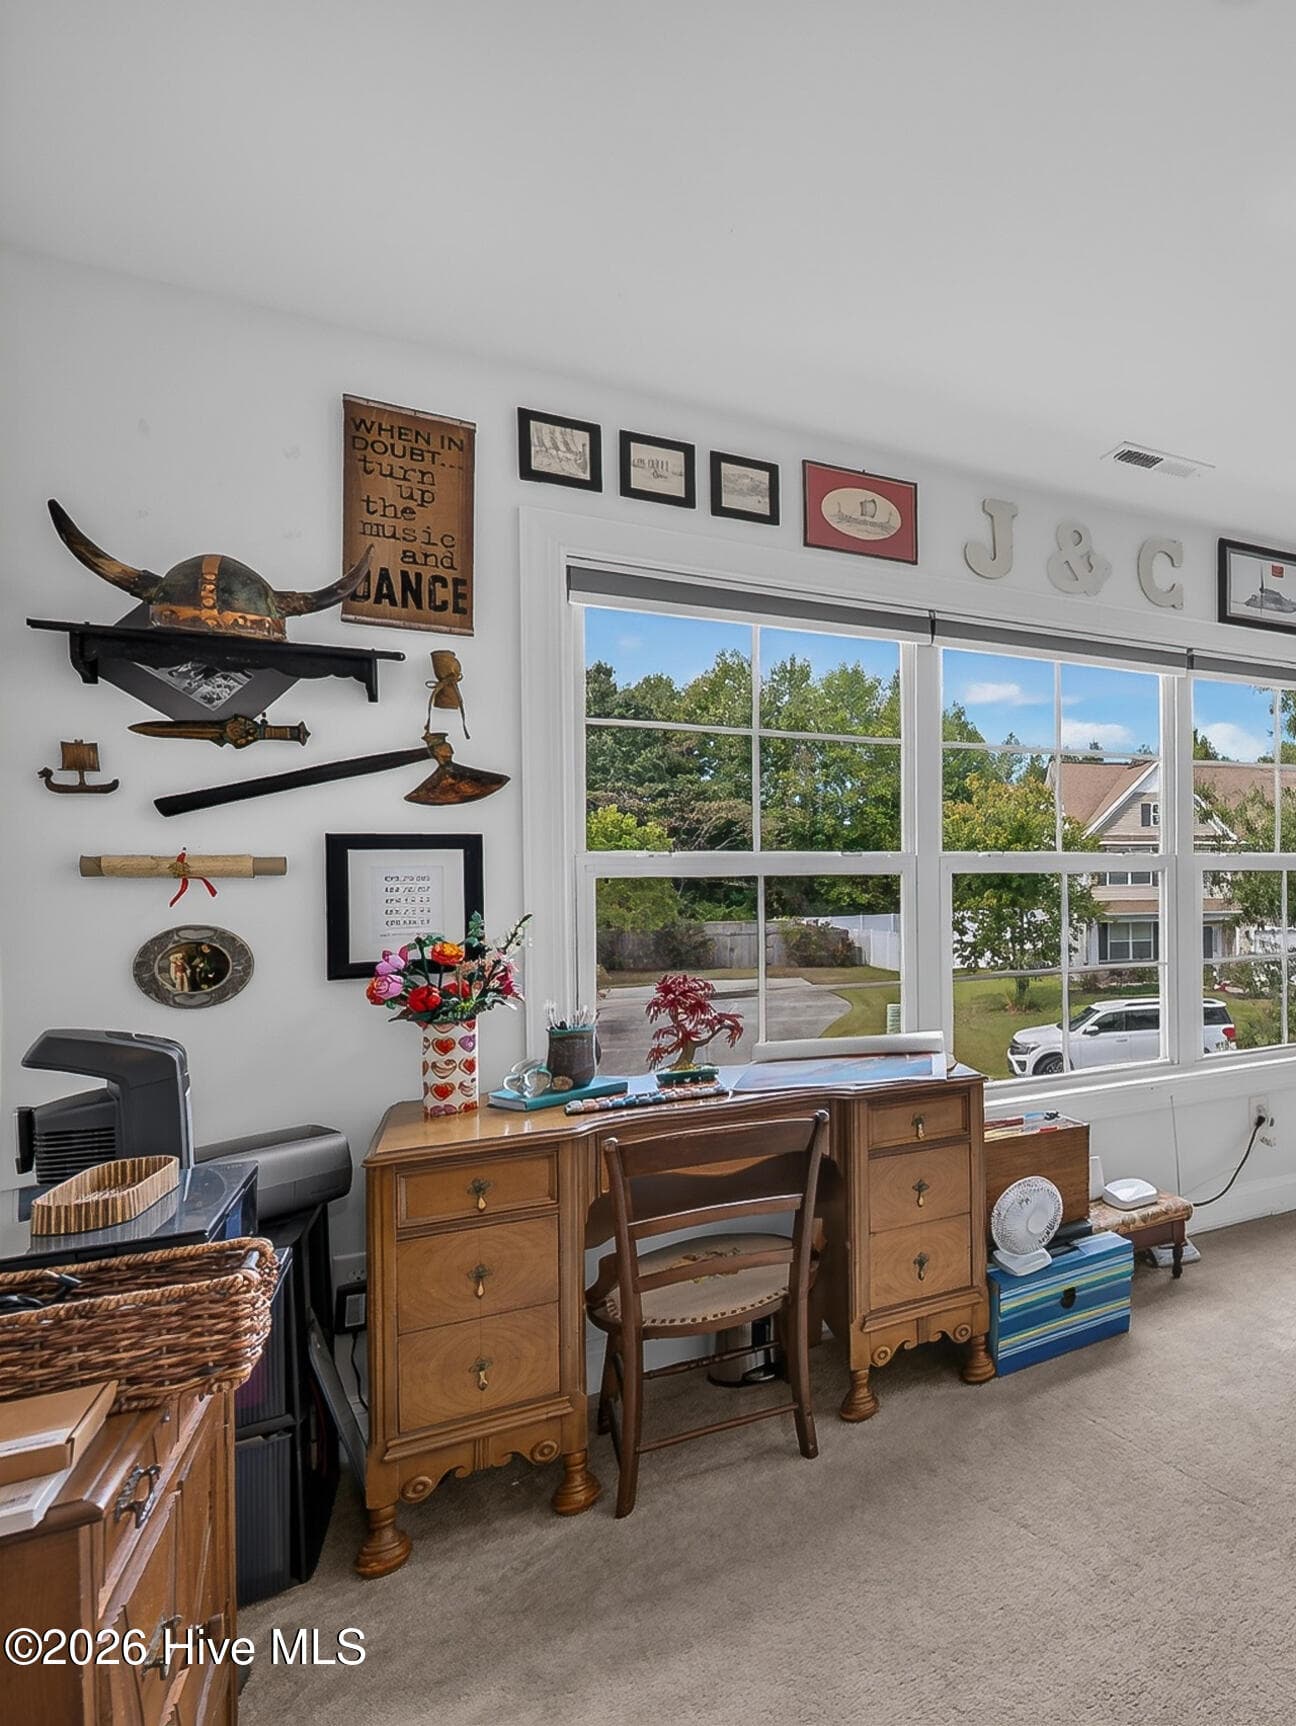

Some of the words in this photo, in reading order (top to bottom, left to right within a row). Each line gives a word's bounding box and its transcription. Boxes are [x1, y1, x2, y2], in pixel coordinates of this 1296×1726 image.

[351, 417, 431, 447] WHEN
[440, 434, 464, 452] IN
[358, 455, 436, 486] turn
[361, 494, 417, 522] the
[396, 484, 435, 508] up
[359, 519, 456, 549] music
[400, 549, 458, 571] and
[964, 499, 1018, 580] J
[1047, 520, 1112, 597] &
[1136, 535, 1184, 610] C
[349, 566, 468, 616] DANCE
